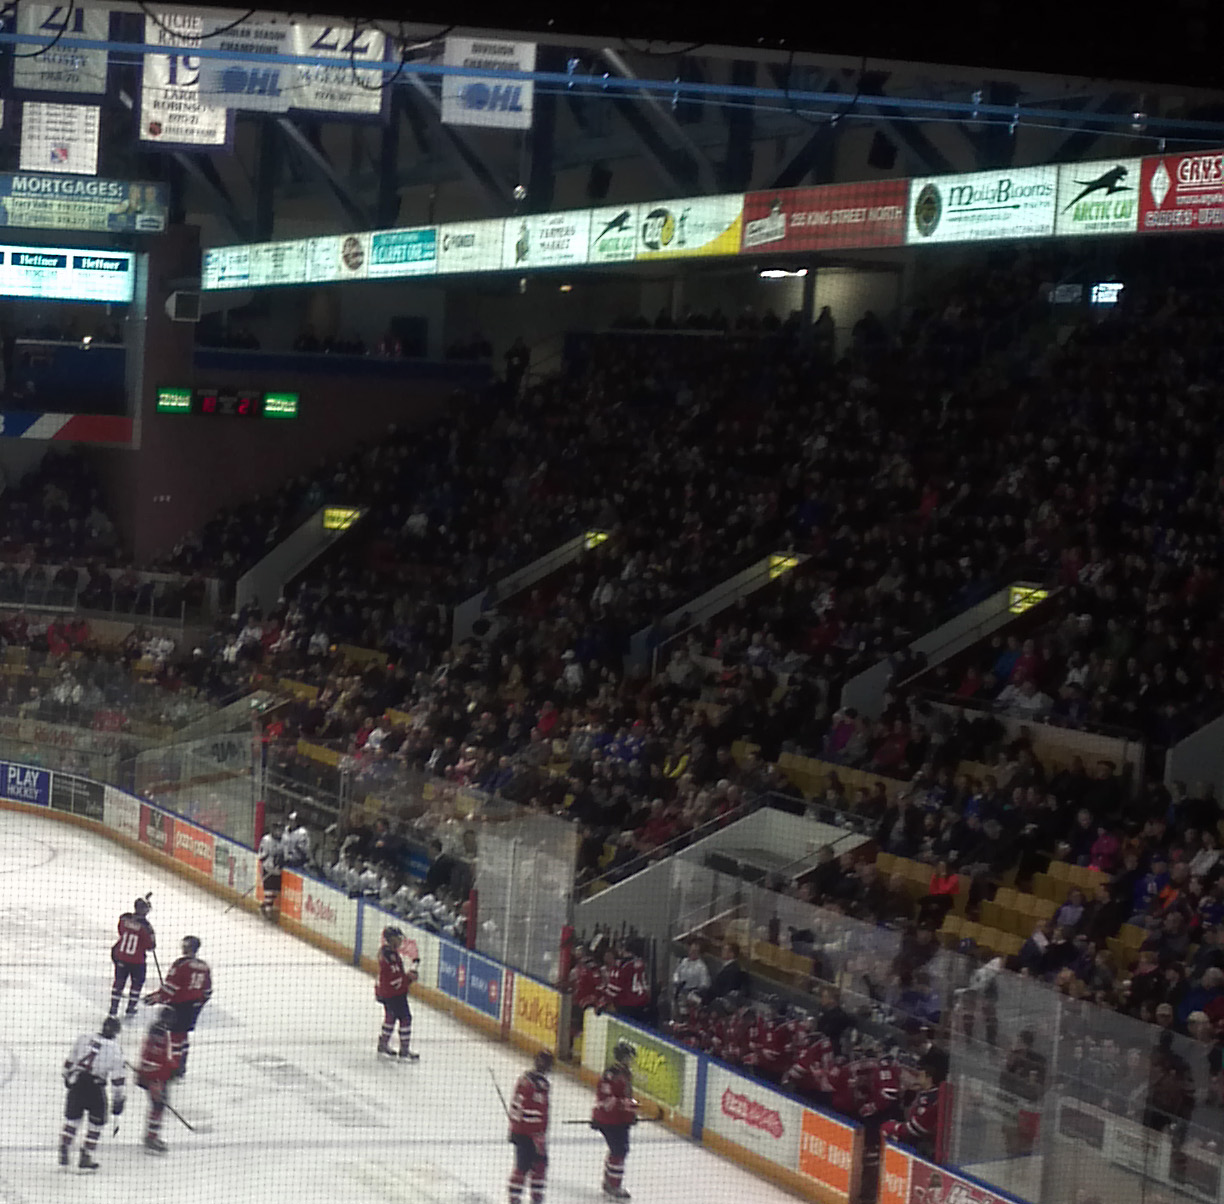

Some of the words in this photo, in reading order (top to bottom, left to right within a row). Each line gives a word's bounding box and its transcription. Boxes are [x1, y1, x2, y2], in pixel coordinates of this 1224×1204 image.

[7, 766, 41, 788] PLAY
[7, 784, 41, 801] HOCKEY
[119, 931, 139, 956] 10
[827, 1144, 851, 1170] HOM
